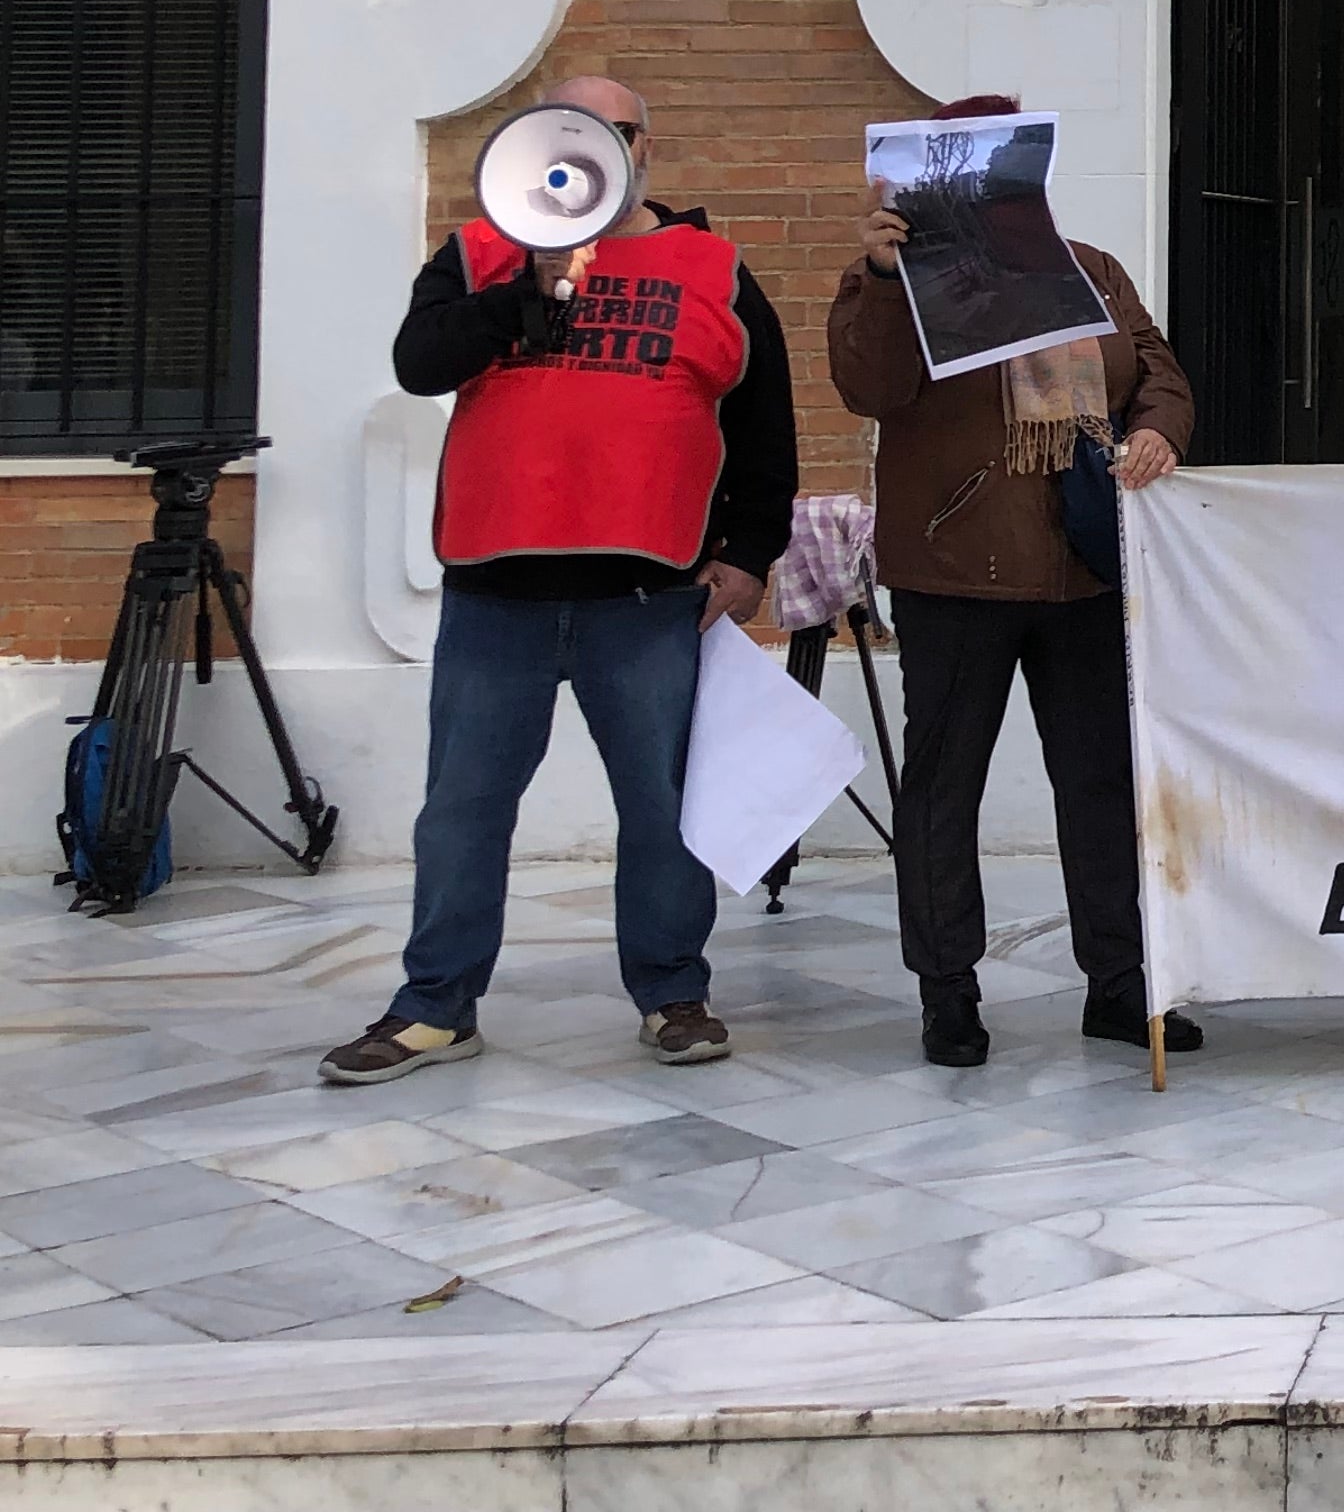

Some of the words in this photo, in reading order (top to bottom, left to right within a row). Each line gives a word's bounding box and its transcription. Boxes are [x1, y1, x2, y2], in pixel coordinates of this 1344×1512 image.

[587, 275, 629, 296] DE
[637, 278, 683, 303] UN
[571, 295, 680, 330] RRIO
[567, 327, 673, 367] RTO
